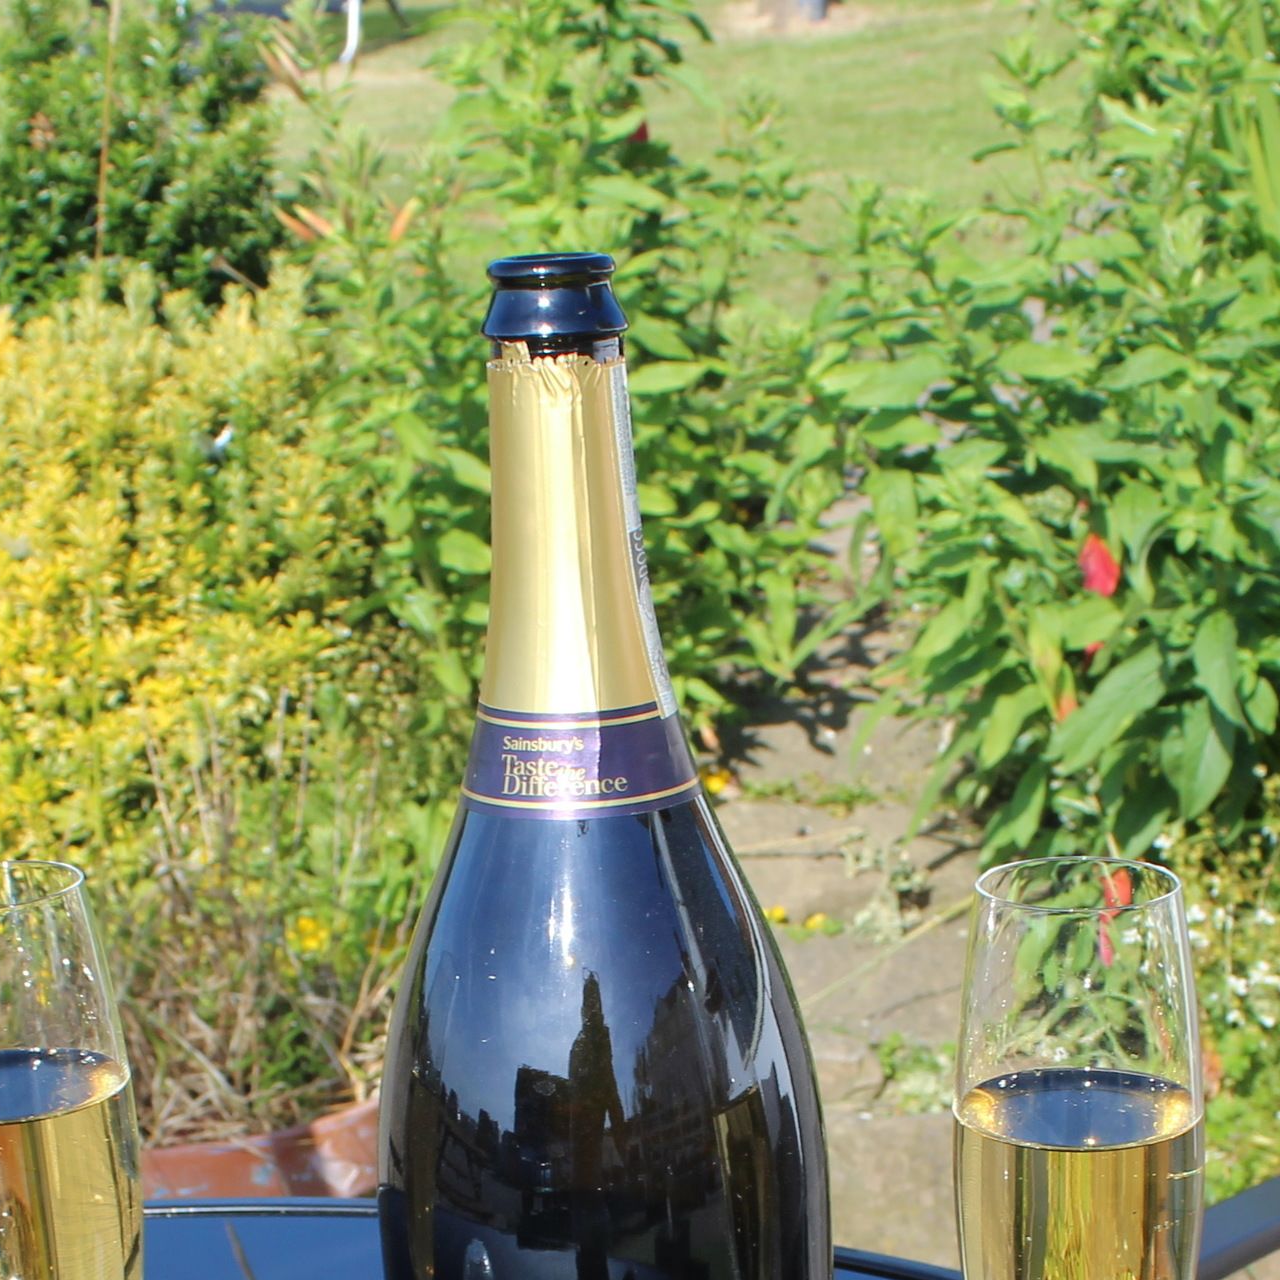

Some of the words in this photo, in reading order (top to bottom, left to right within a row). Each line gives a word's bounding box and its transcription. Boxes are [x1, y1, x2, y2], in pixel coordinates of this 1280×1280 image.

[503, 736, 585, 754] Sainsbury's
[501, 754, 558, 776] Taste
[501, 774, 629, 797] Difference
